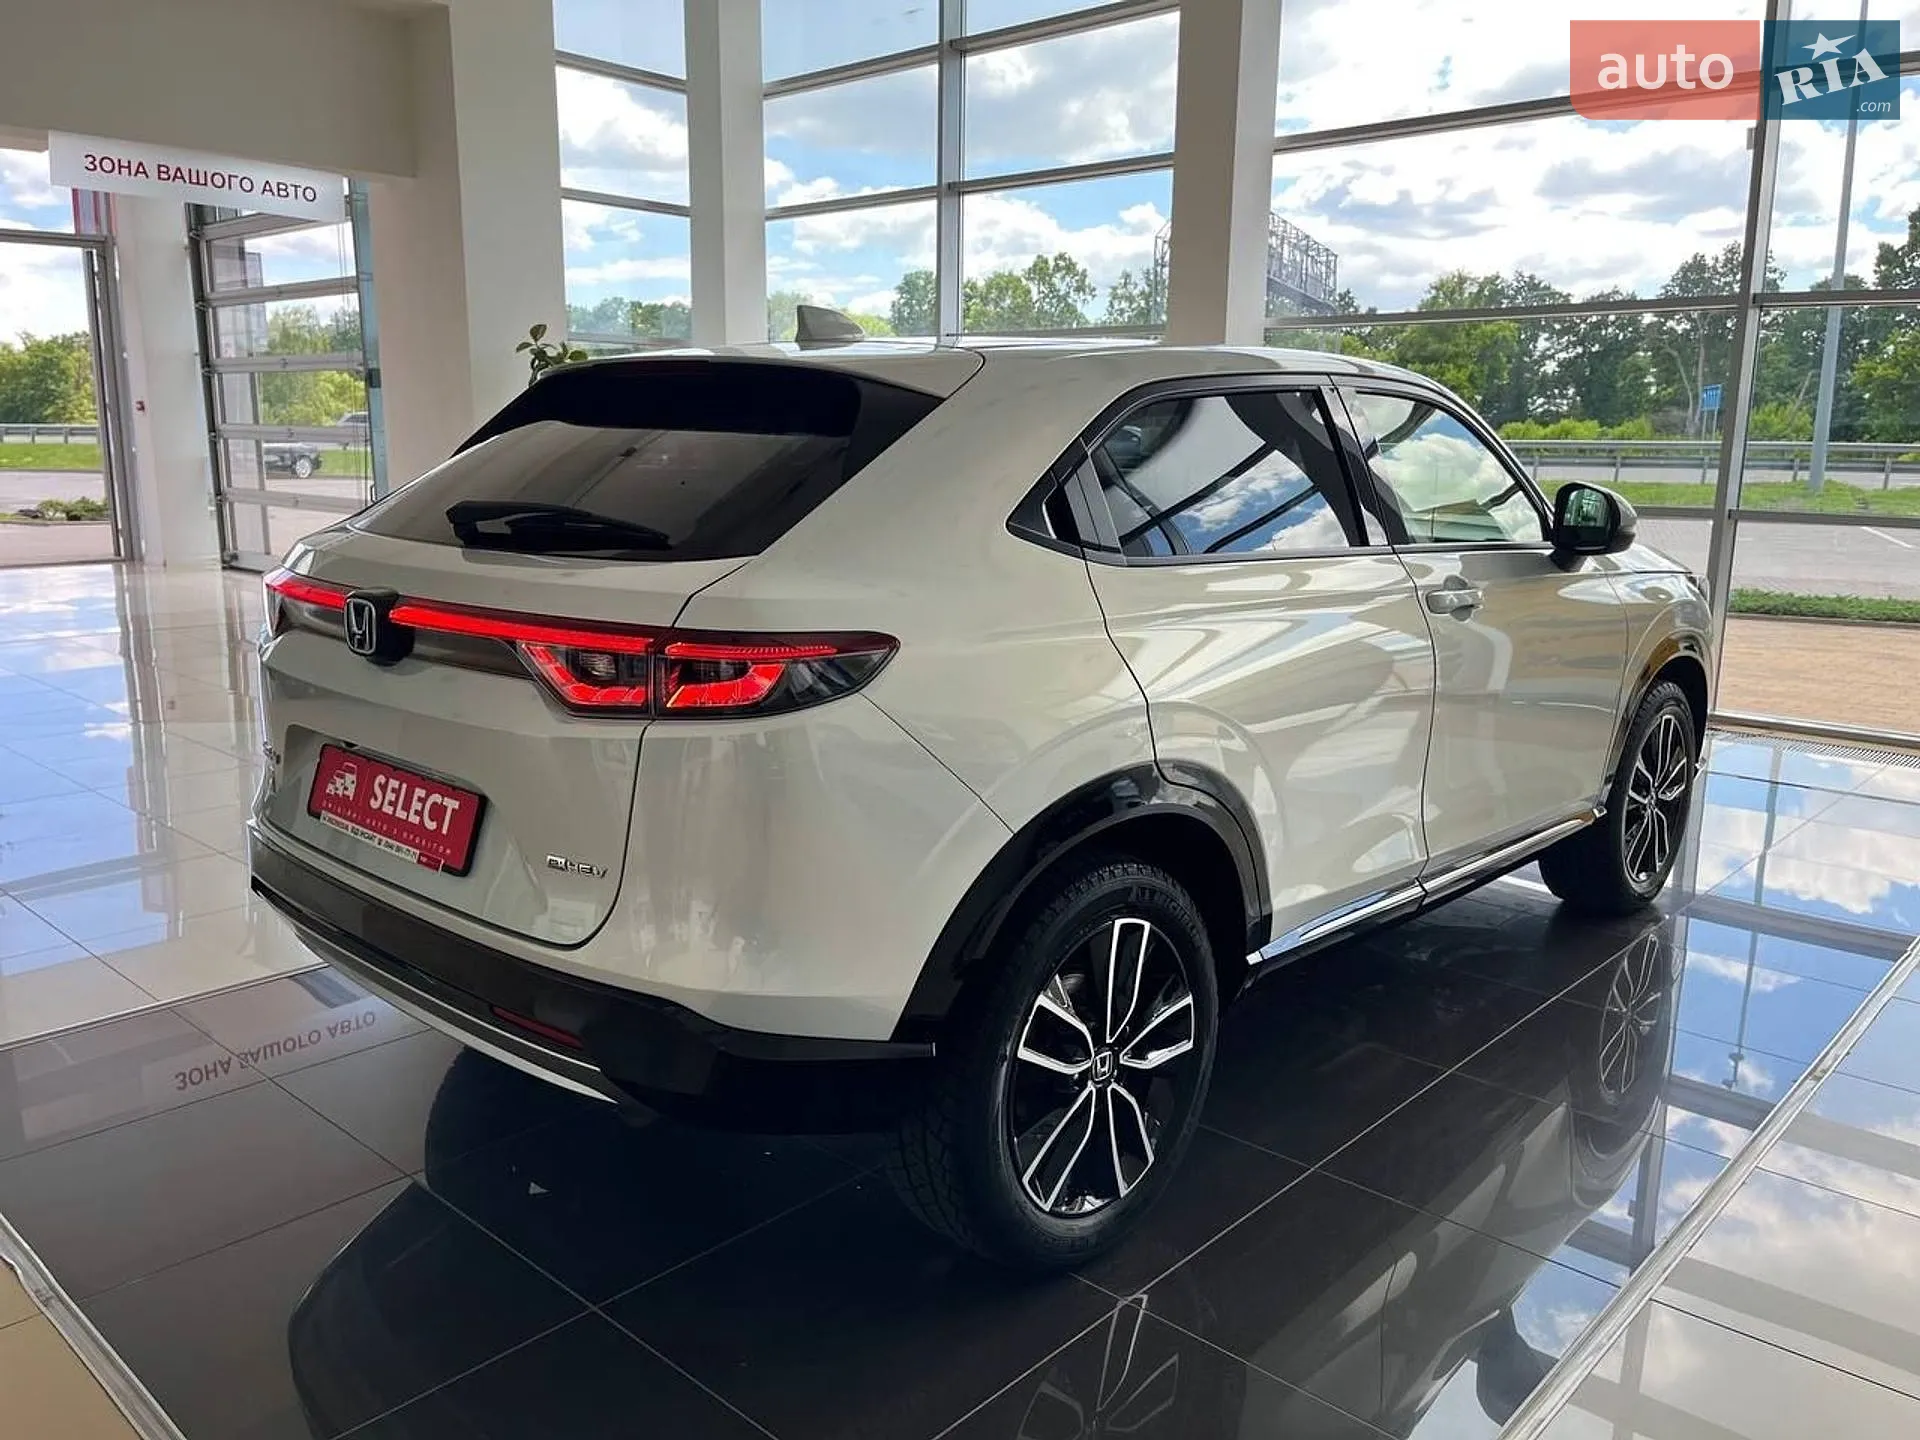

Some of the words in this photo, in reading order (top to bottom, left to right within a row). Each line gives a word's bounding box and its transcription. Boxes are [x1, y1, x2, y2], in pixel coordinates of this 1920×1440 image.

[84, 154, 149, 179] ЗОНА
[156, 163, 255, 194] ВАШОГО
[261, 179, 317, 203] АВТО
[369, 774, 460, 836] SELECT
